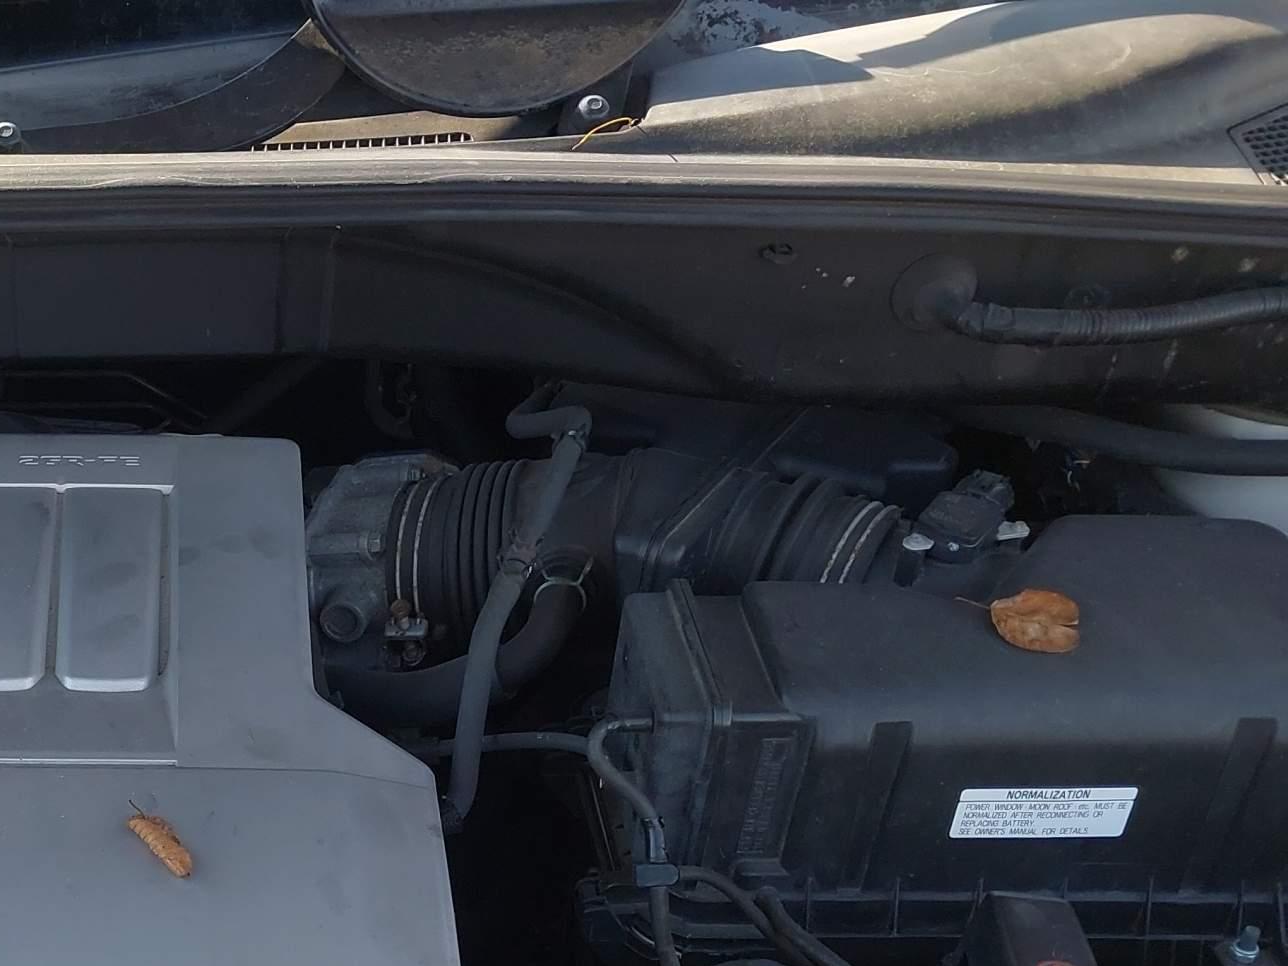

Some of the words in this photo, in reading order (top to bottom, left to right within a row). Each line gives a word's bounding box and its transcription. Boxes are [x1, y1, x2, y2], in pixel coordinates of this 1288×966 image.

[1006, 790, 1091, 800] NORMALIZATION
[965, 803, 990, 811] POWER
[994, 803, 1024, 811] WINDOW
[1029, 803, 1050, 811] MOON
[1053, 803, 1072, 811] ROOF
[1093, 802, 1114, 810] MUST
[1118, 802, 1129, 810] BE
[963, 811, 1007, 819] NORMALIZED
[1010, 811, 1034, 819] AFTER
[1036, 811, 1089, 819] RECONNECTING
[960, 820, 999, 828] REPLACING
[958, 828, 972, 836] SEE
[974, 828, 1006, 836] OWNER'S
